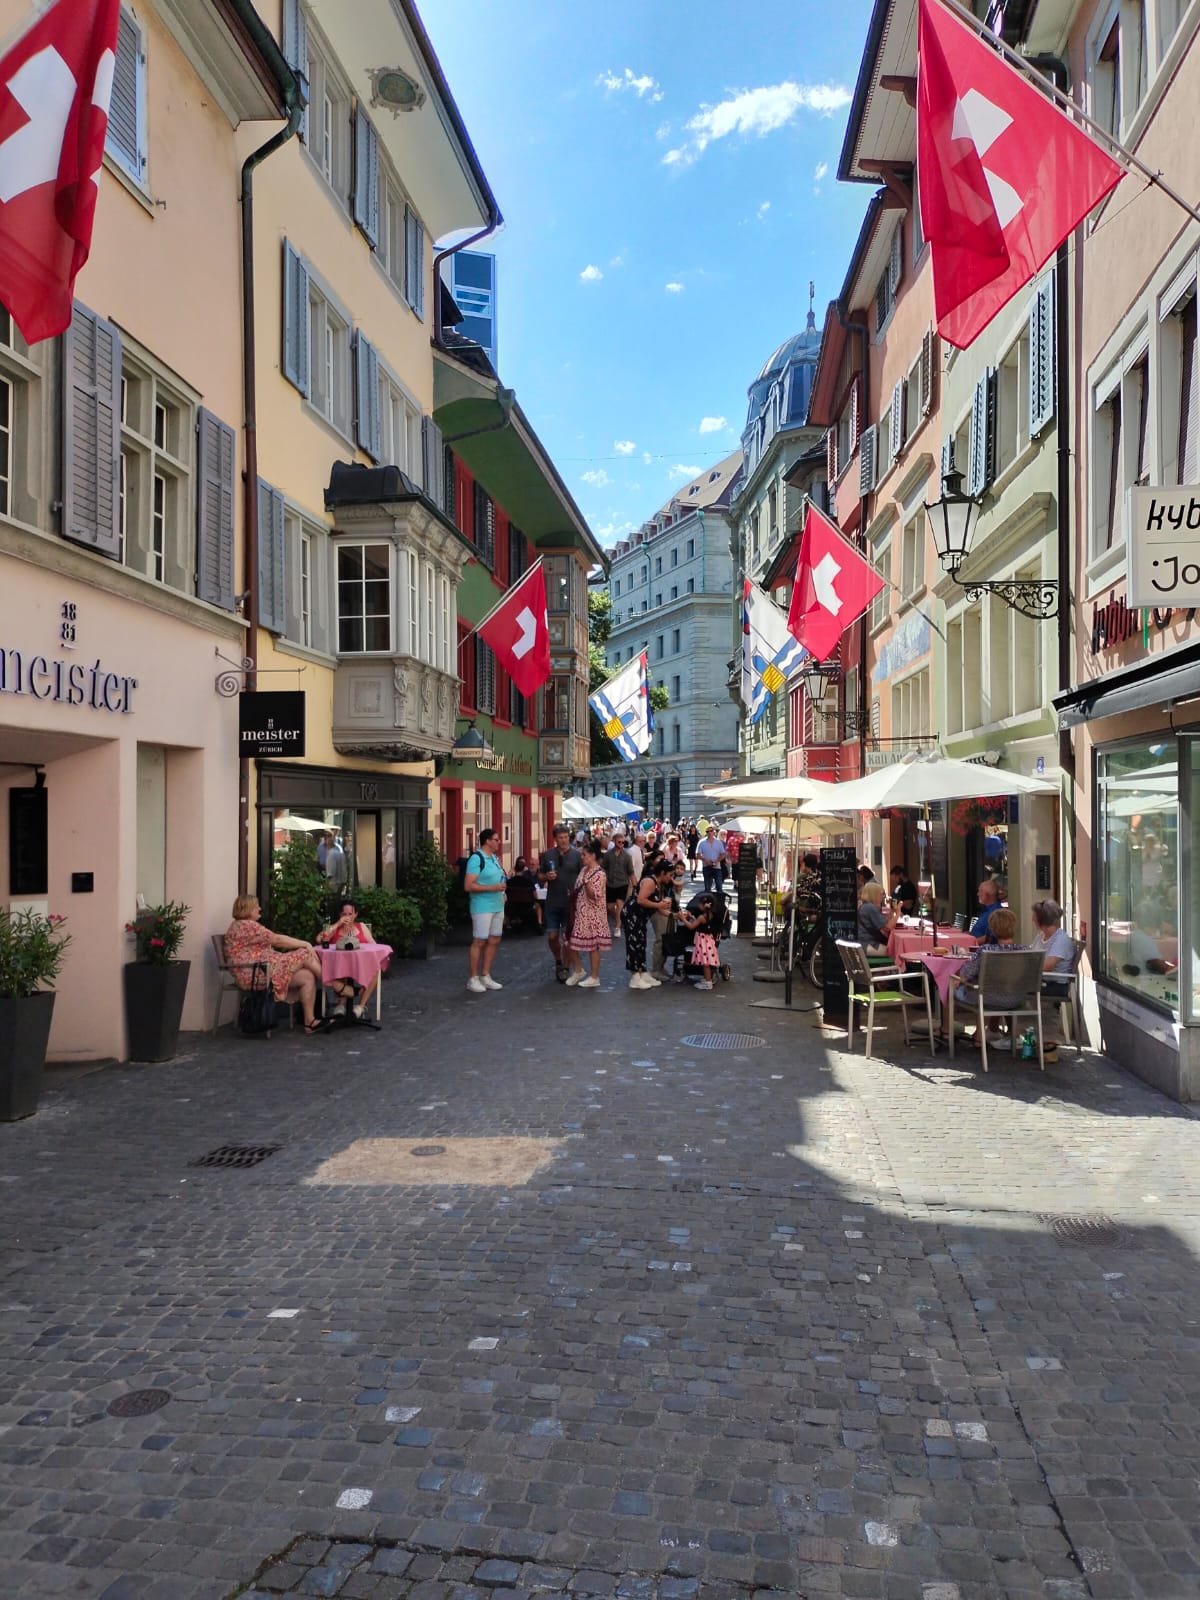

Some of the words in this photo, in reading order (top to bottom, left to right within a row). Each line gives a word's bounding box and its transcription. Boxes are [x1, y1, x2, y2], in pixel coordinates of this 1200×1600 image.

[61, 601, 77, 620] 18
[61, 622, 76, 641] 81
[241, 729, 300, 741] meister
